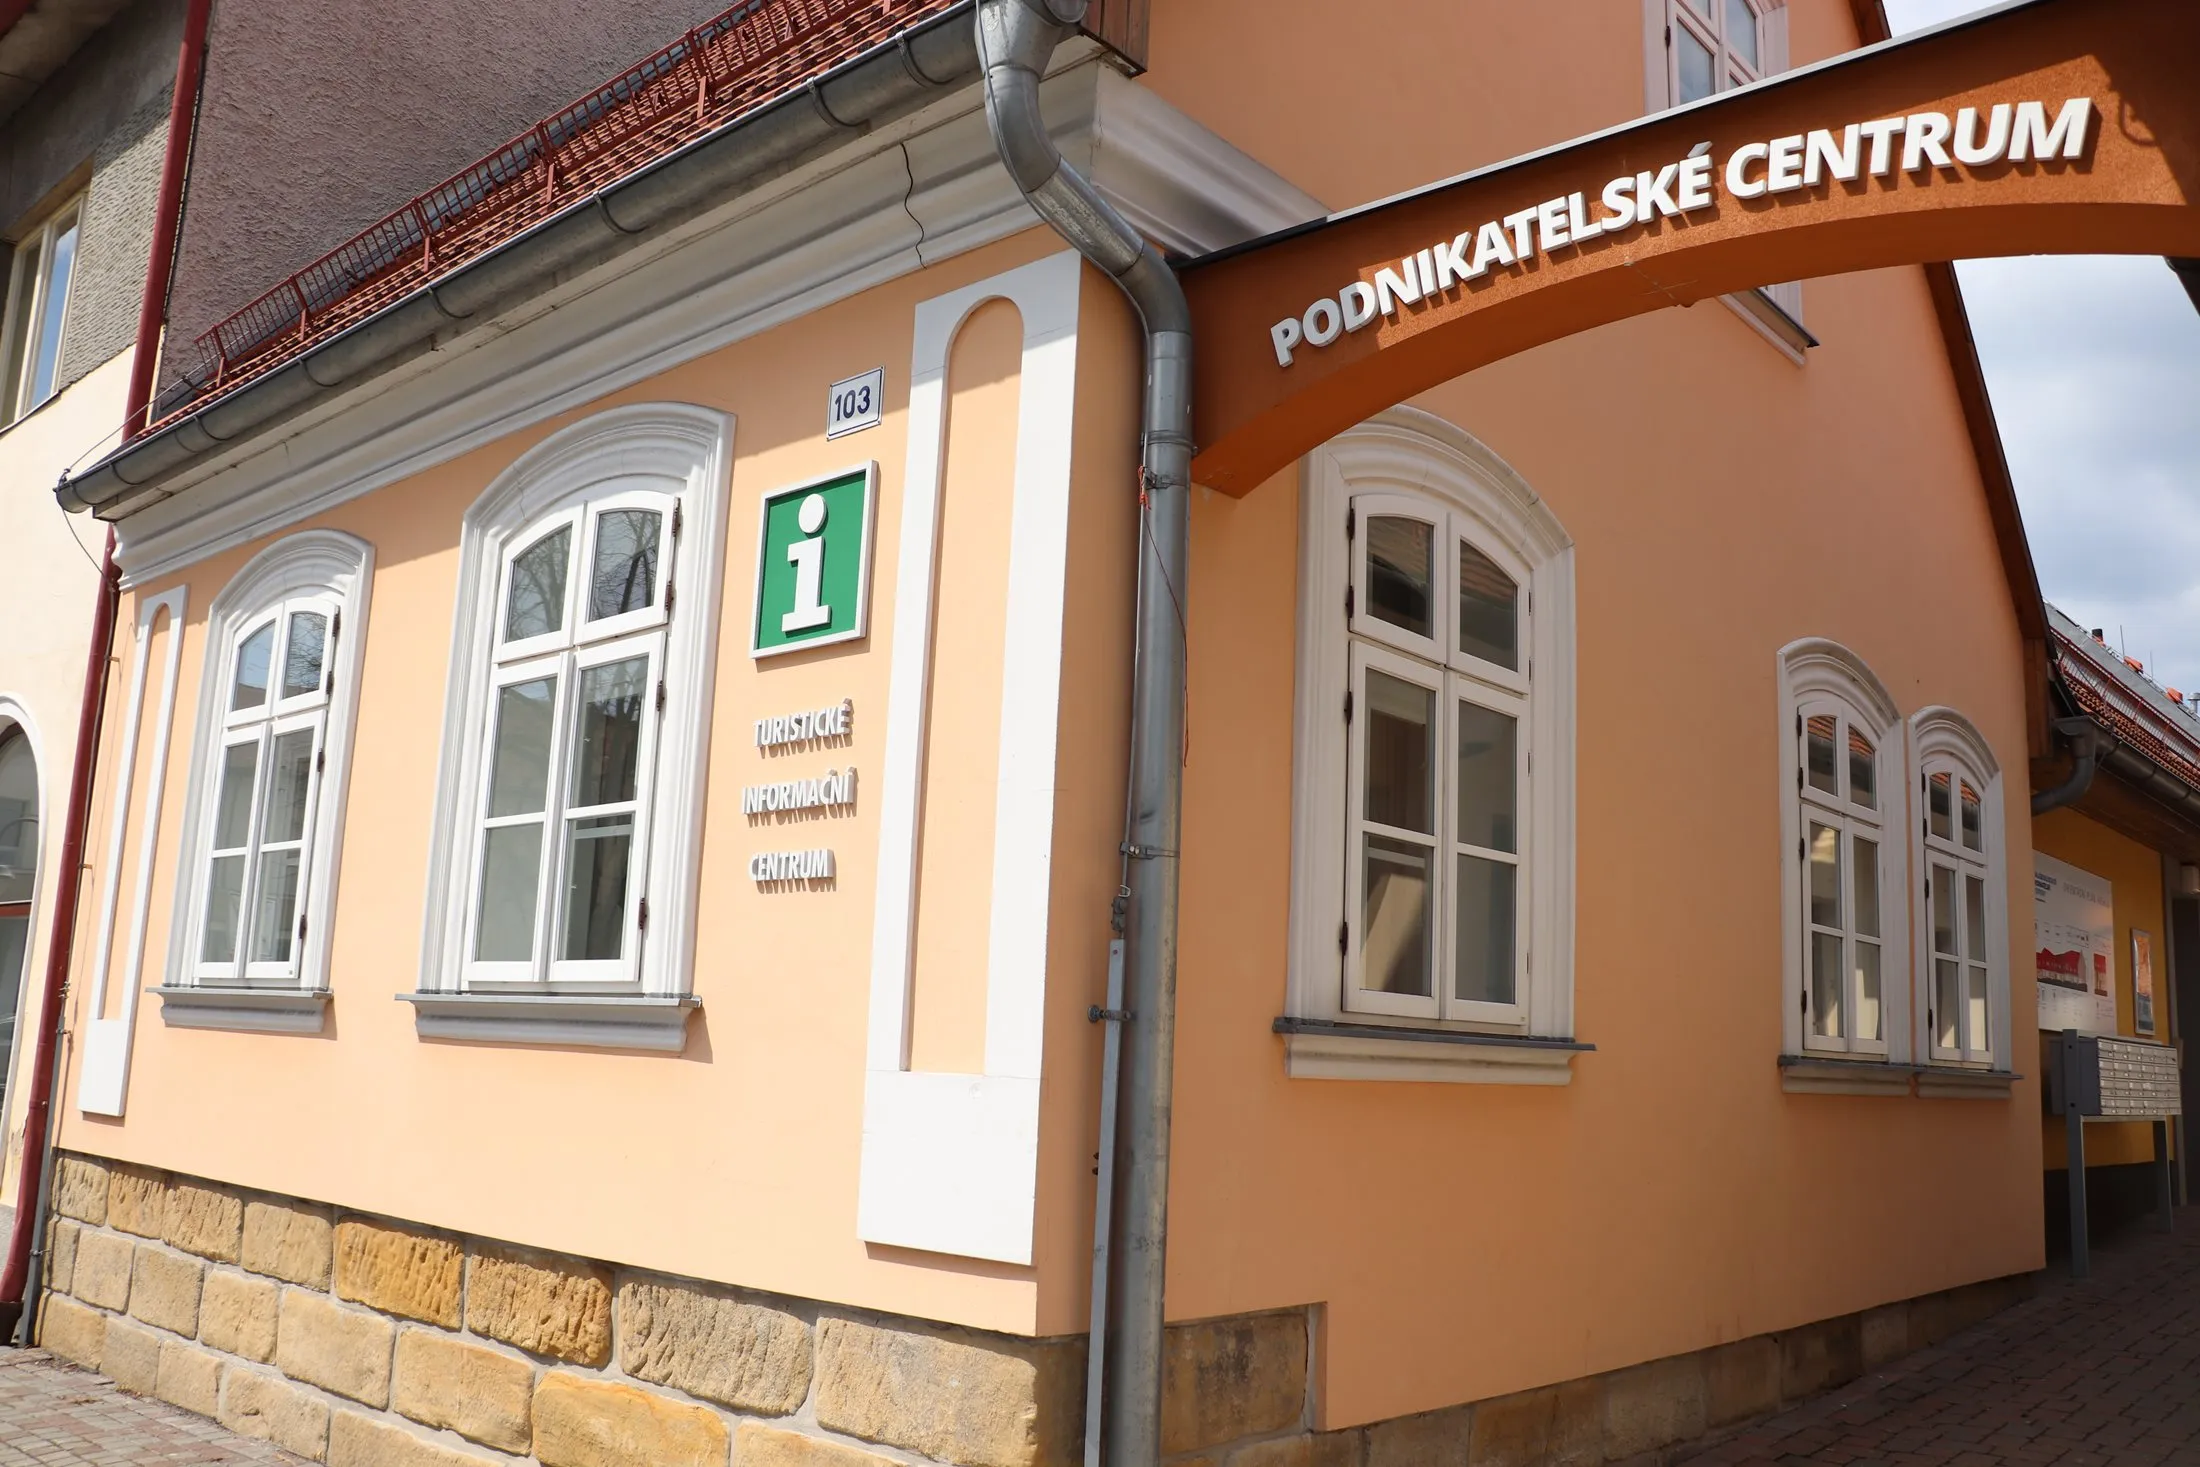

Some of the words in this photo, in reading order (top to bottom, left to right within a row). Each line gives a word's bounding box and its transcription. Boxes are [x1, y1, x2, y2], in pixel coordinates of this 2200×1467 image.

[1270, 141, 1713, 368] PODNIKATELSKÉ
[1725, 97, 2092, 199] CENTRUM
[835, 385, 870, 421] 103
[753, 698, 853, 747] TURISTICKÉ
[741, 767, 857, 815] INFORMAČNÍ
[749, 848, 835, 881] CENTRUM
